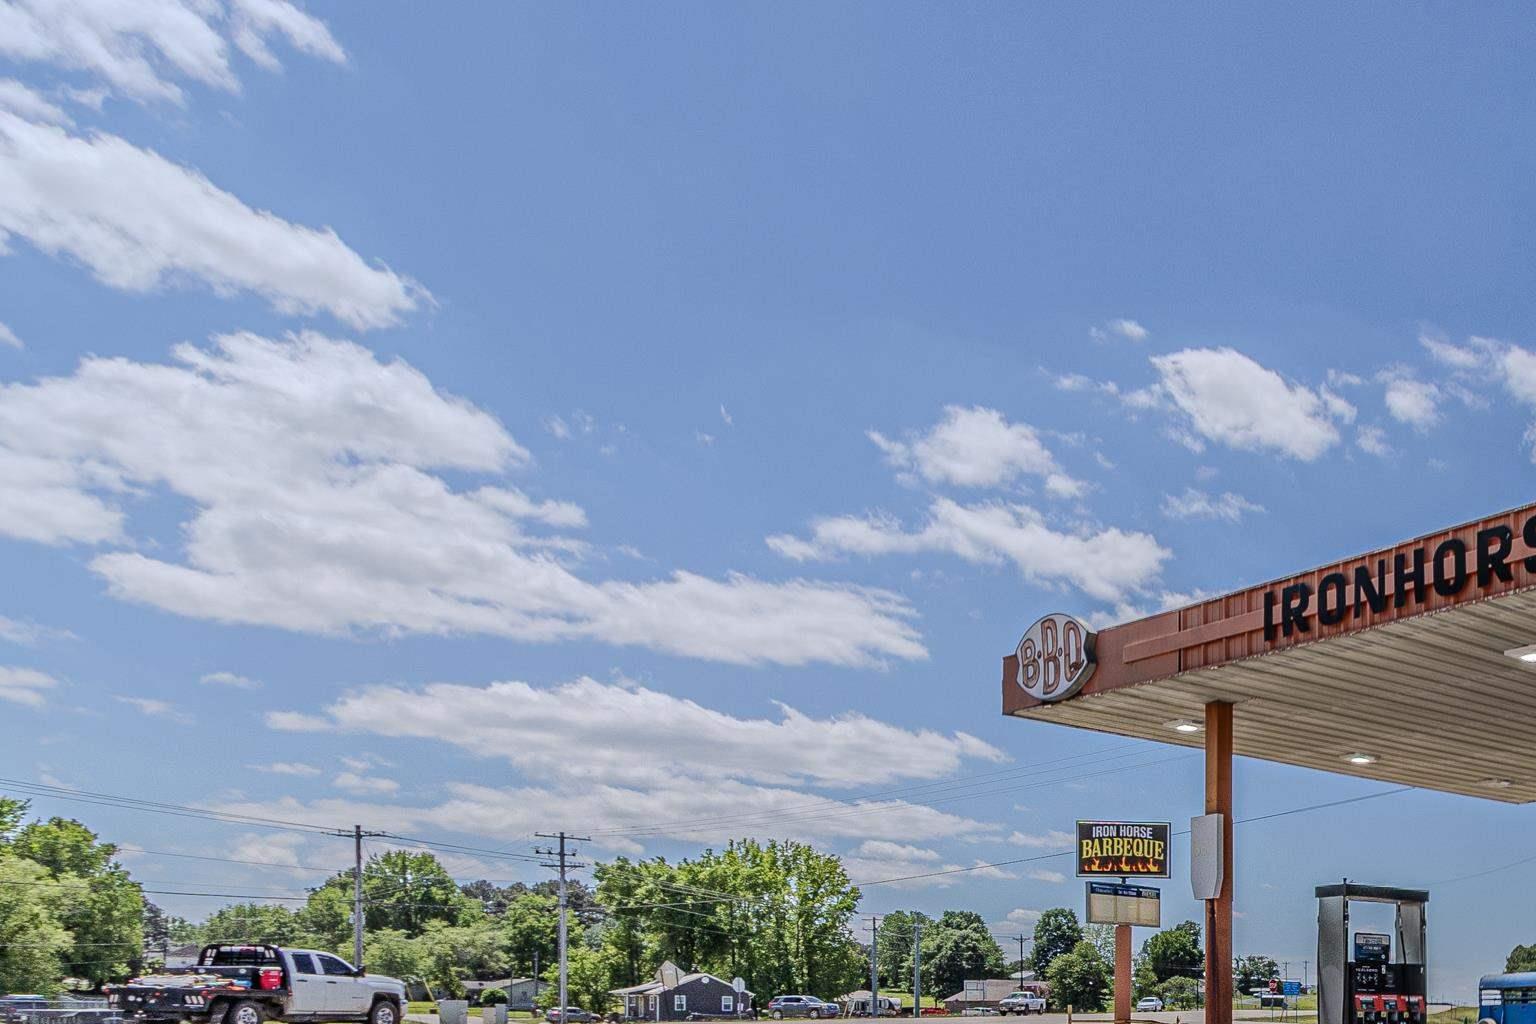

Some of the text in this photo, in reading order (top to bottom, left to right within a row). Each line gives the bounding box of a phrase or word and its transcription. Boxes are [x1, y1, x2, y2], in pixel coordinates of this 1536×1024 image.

[1093, 826, 1152, 839] IRON HORSE
[1082, 838, 1164, 859] BARBEQUE
